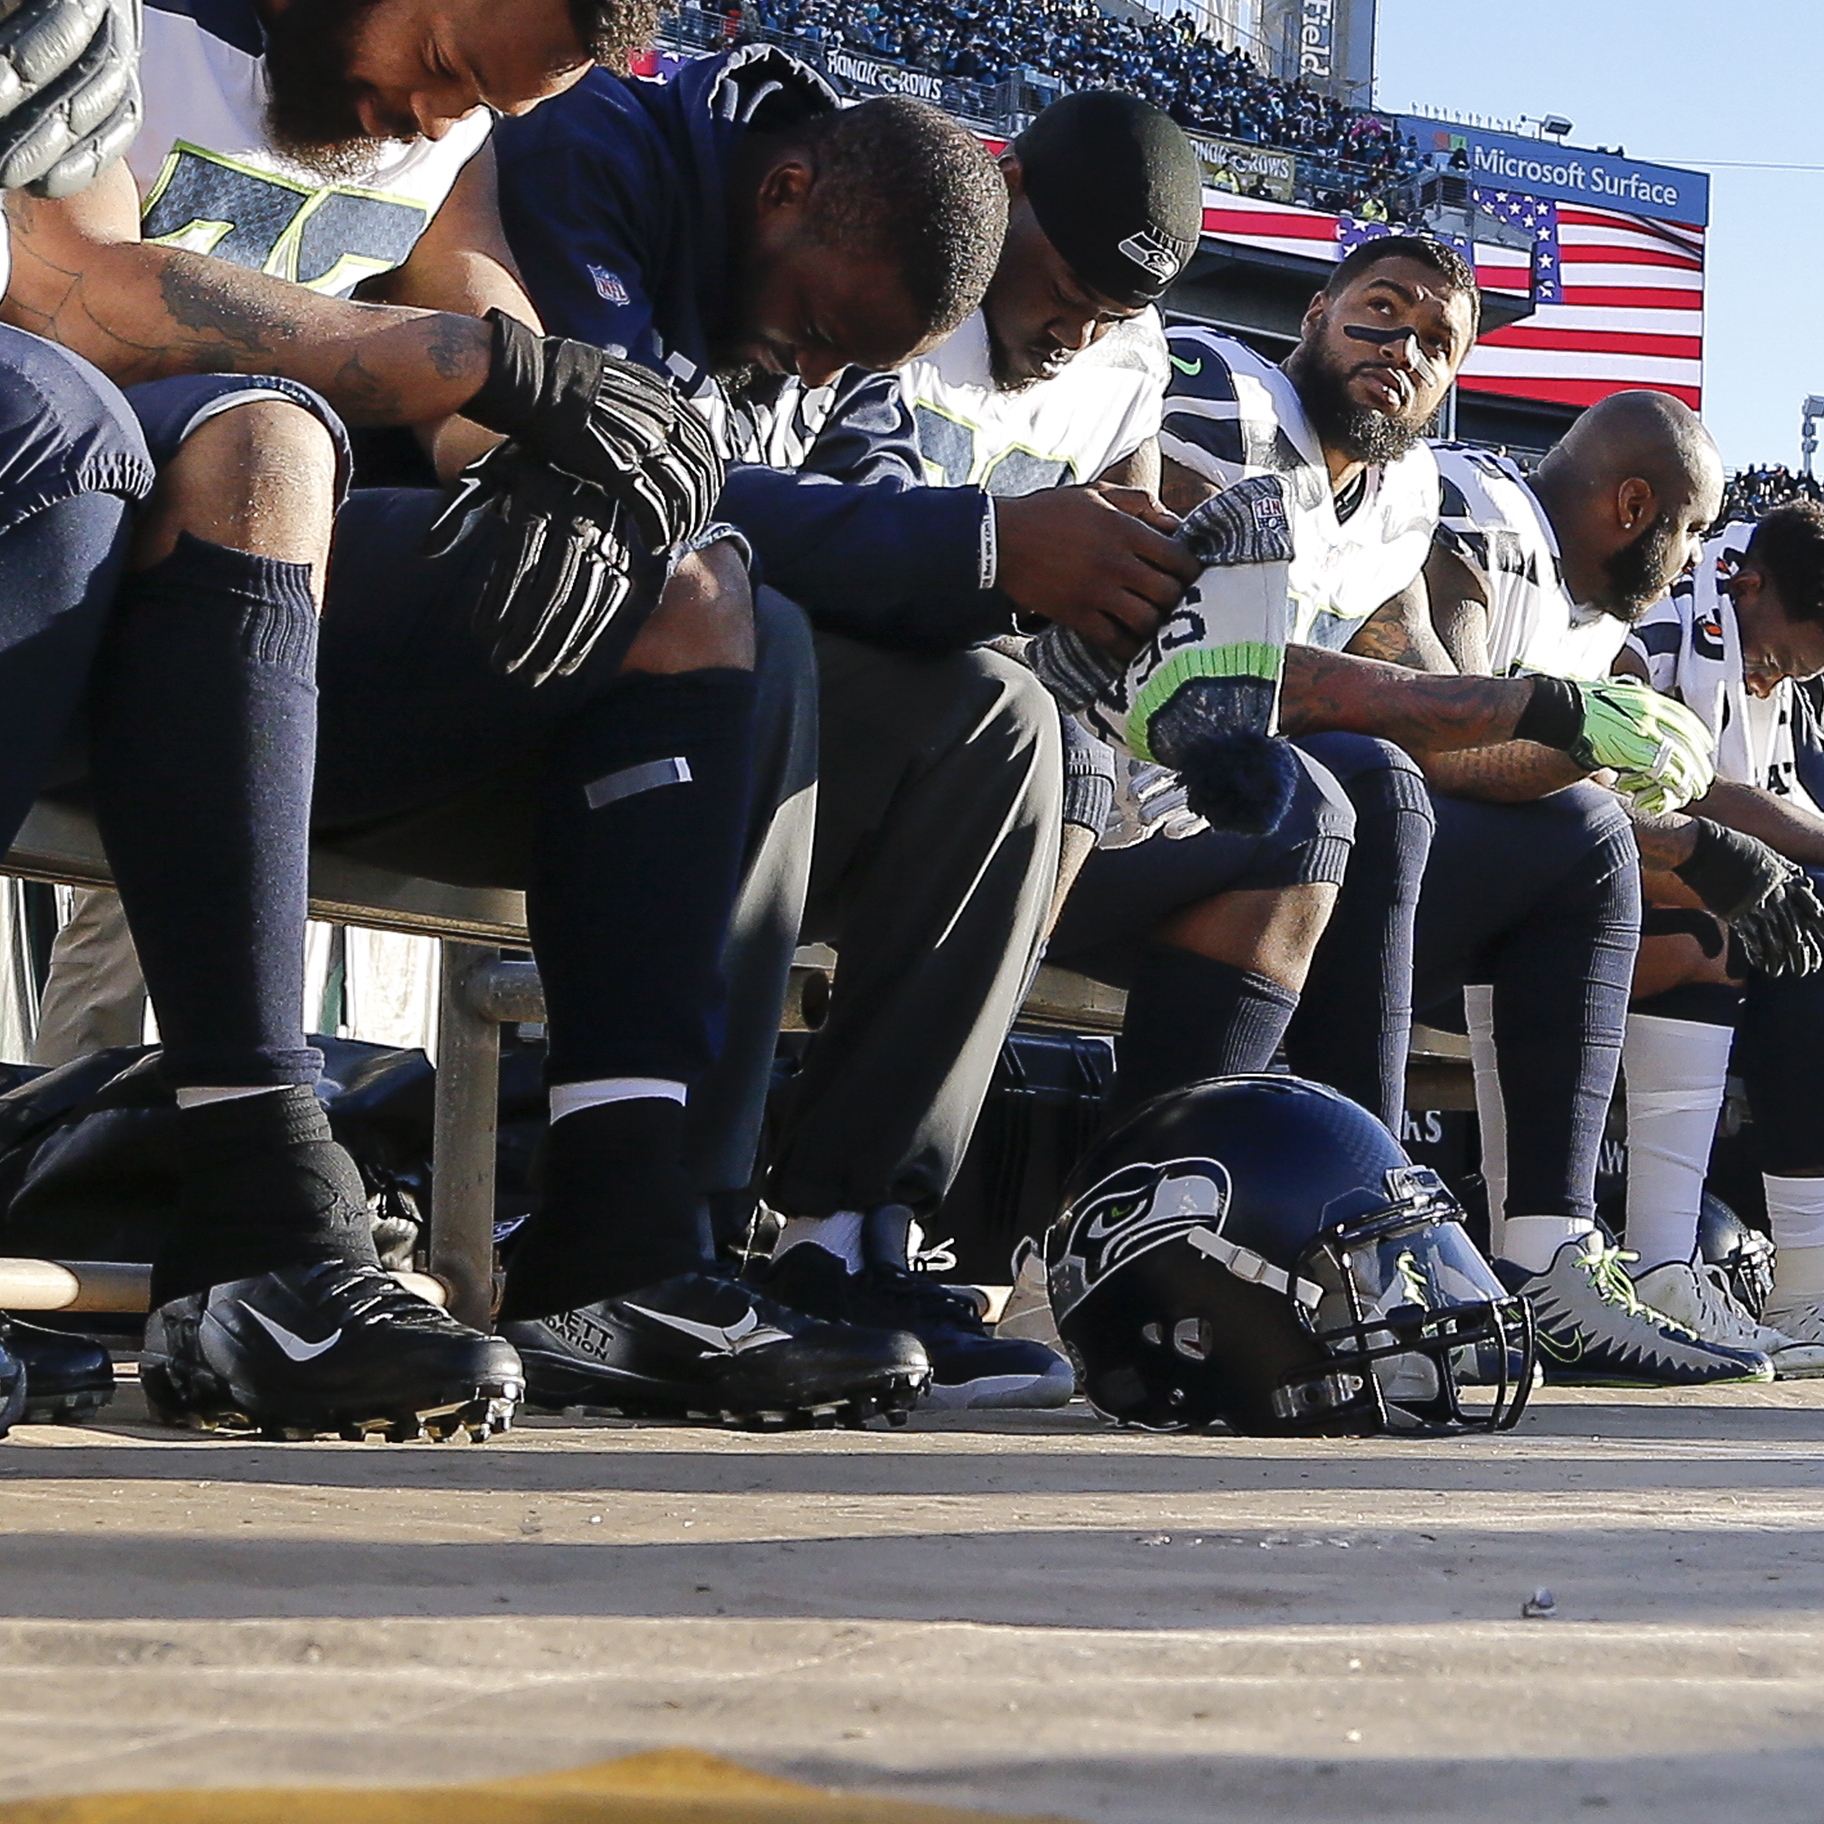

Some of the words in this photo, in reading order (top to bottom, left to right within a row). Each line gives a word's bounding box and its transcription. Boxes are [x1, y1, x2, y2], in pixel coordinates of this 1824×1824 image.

[827, 55, 880, 87] HONOR
[899, 71, 943, 100] ROWS
[1473, 144, 1586, 190] Microsoft
[1590, 167, 1678, 206] Surface
